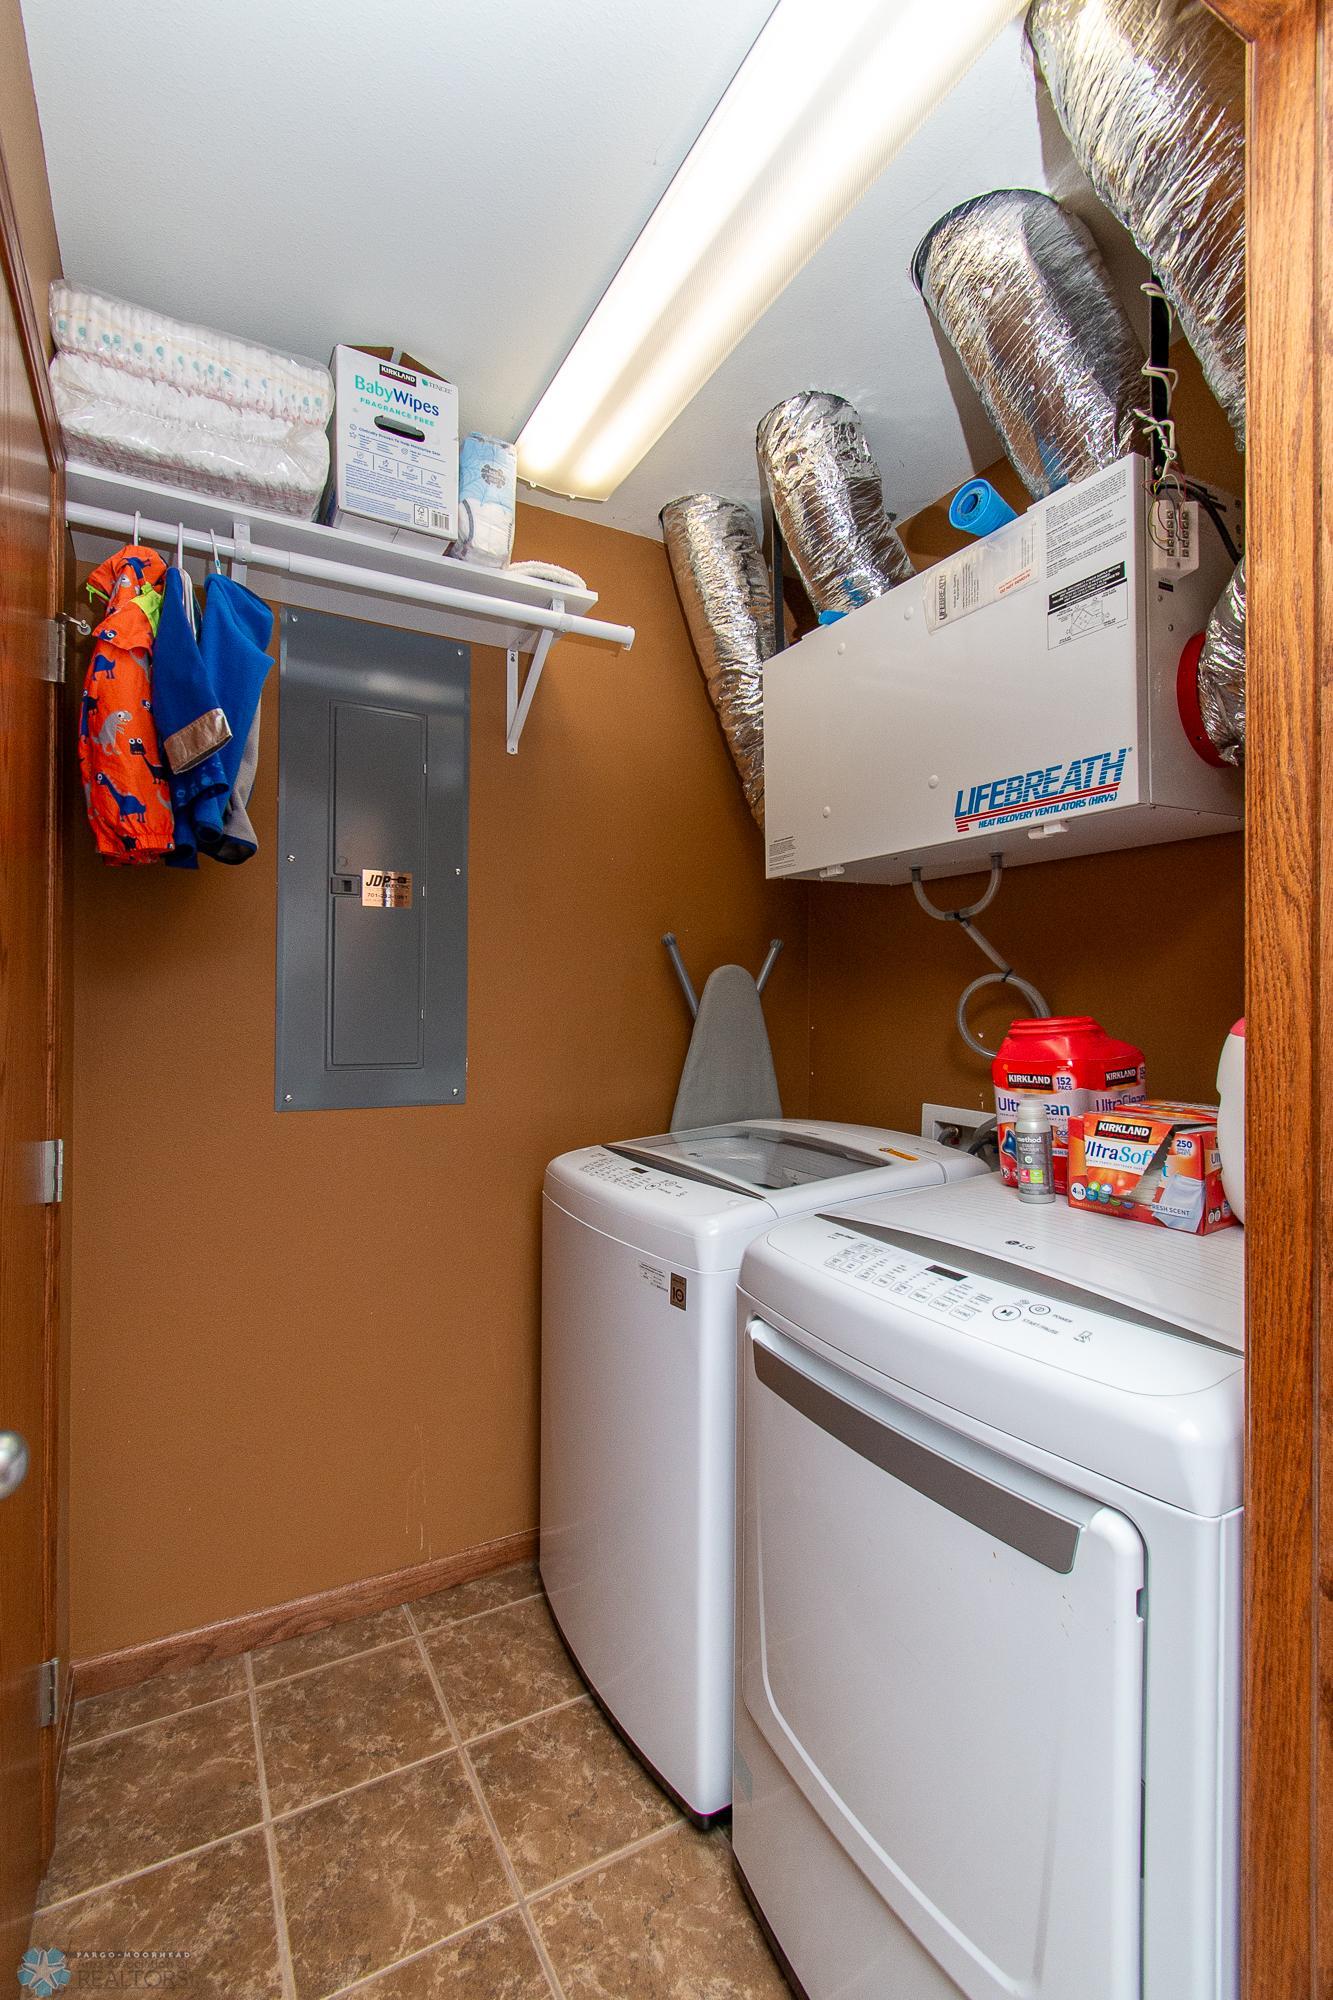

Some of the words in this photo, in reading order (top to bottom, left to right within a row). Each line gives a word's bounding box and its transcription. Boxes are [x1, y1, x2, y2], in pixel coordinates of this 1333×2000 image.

[381, 366, 415, 382] KIRKLAND
[354, 374, 440, 416] BabyWipes
[360, 397, 413, 419] FRAGRANCE
[414, 415, 435, 427] FREE
[954, 747, 1127, 818] LIFEBREATH
[978, 818, 996, 829] HEAT
[997, 810, 1034, 825] RECOVERY
[1035, 800, 1087, 816] VENTILATORS
[1088, 791, 1118, 806] (HRVs)
[1008, 1074, 1051, 1085] KIRKLAND
[1056, 1077, 1072, 1086] 152
[1106, 1068, 1137, 1081] KIRKLAND
[1098, 1122, 1150, 1137] KIRKLAND
[1176, 1139, 1193, 1149] 250
[1169, 1207, 1190, 1216] SCENT
